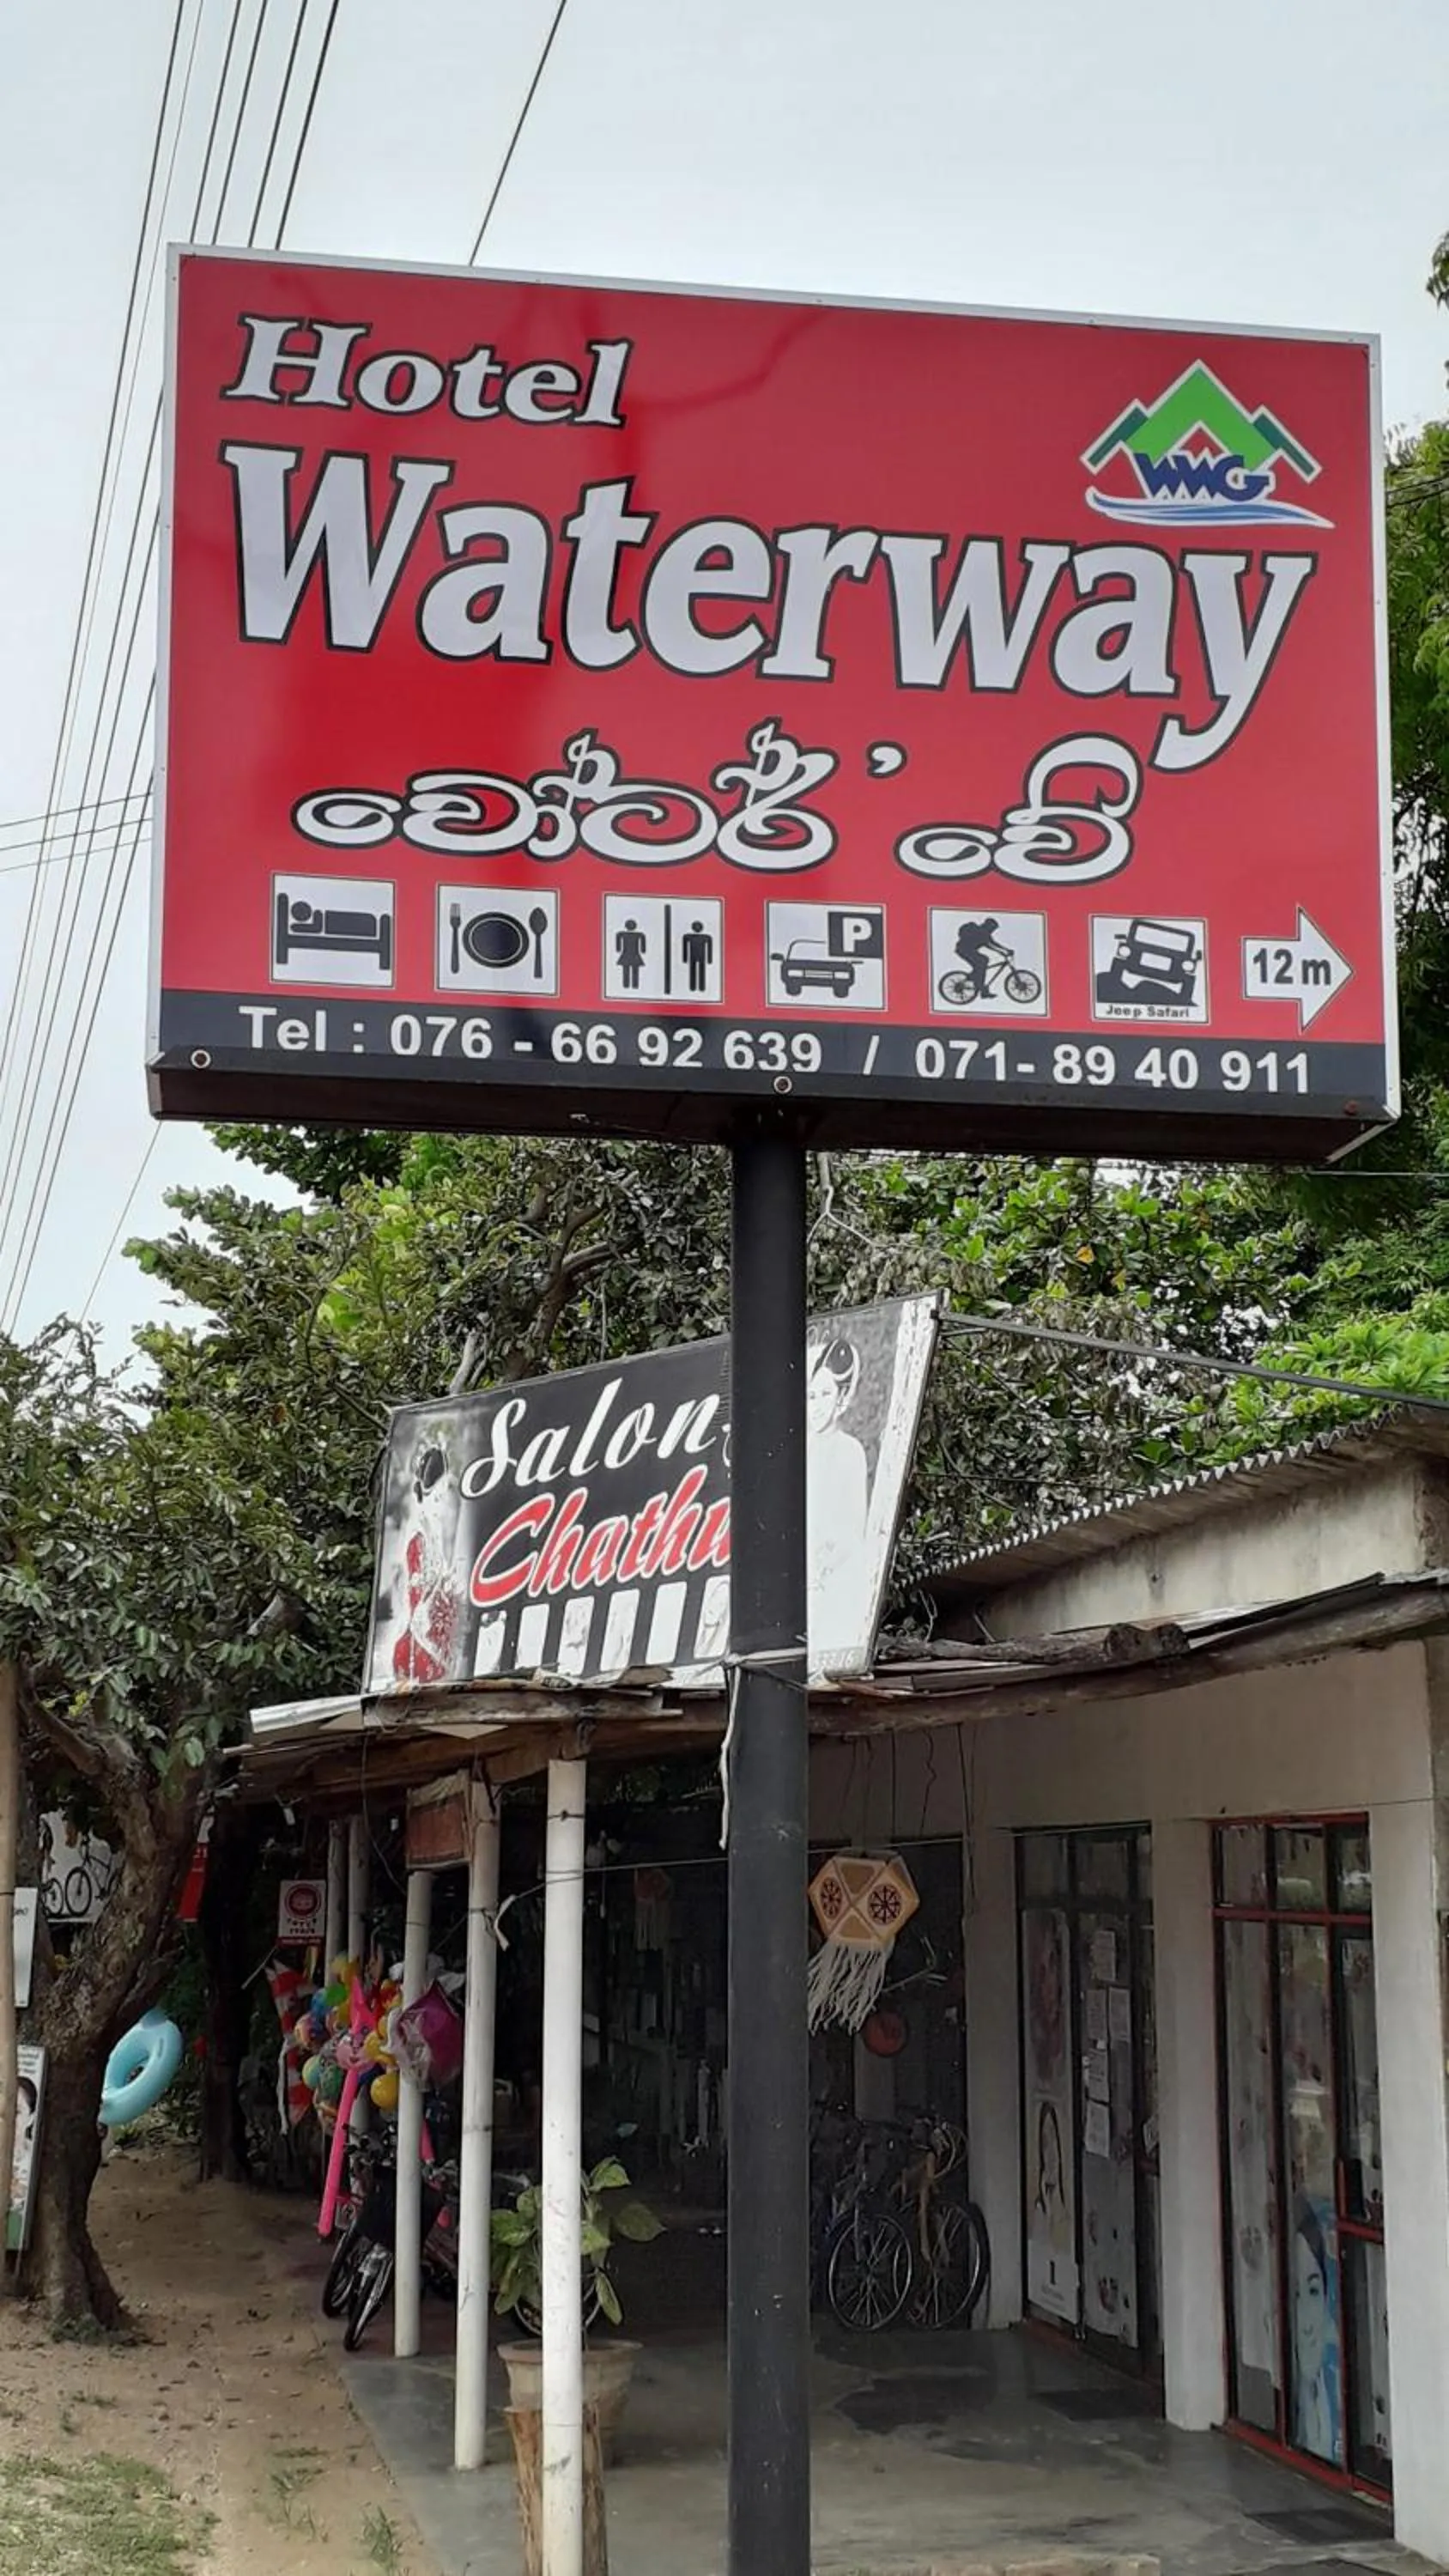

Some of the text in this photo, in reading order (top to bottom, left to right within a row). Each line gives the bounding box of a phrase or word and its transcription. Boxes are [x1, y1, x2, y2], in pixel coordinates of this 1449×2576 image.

[220, 313, 634, 428] Hotel
[220, 440, 1319, 773] Waterway
[842, 917, 873, 953] P
[391, 1014, 493, 1059] 076
[551, 1022, 617, 1064] 66
[638, 1026, 703, 1067] 92
[724, 1030, 822, 1072] 639
[1052, 1043, 1116, 1086] 89
[1134, 1047, 1198, 1089] 40
[1220, 1050, 1307, 1093] 911
[1147, 1005, 1190, 1018] Safari
[460, 1377, 721, 1499] Salon
